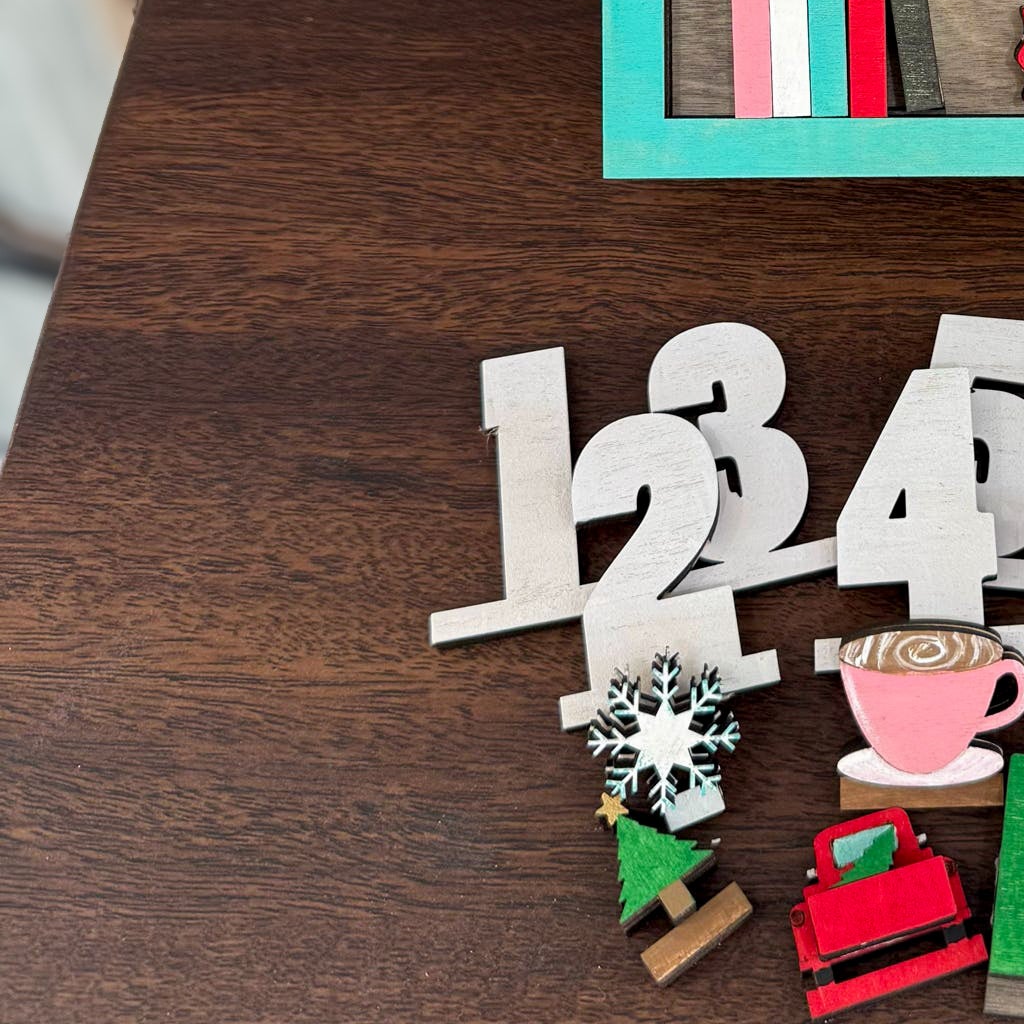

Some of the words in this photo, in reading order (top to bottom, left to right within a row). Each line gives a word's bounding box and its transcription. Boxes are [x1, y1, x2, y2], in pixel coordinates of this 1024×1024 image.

[480, 346, 582, 602] 1
[571, 413, 742, 692] 2
[648, 322, 809, 566] 3
[837, 367, 998, 626] 4
